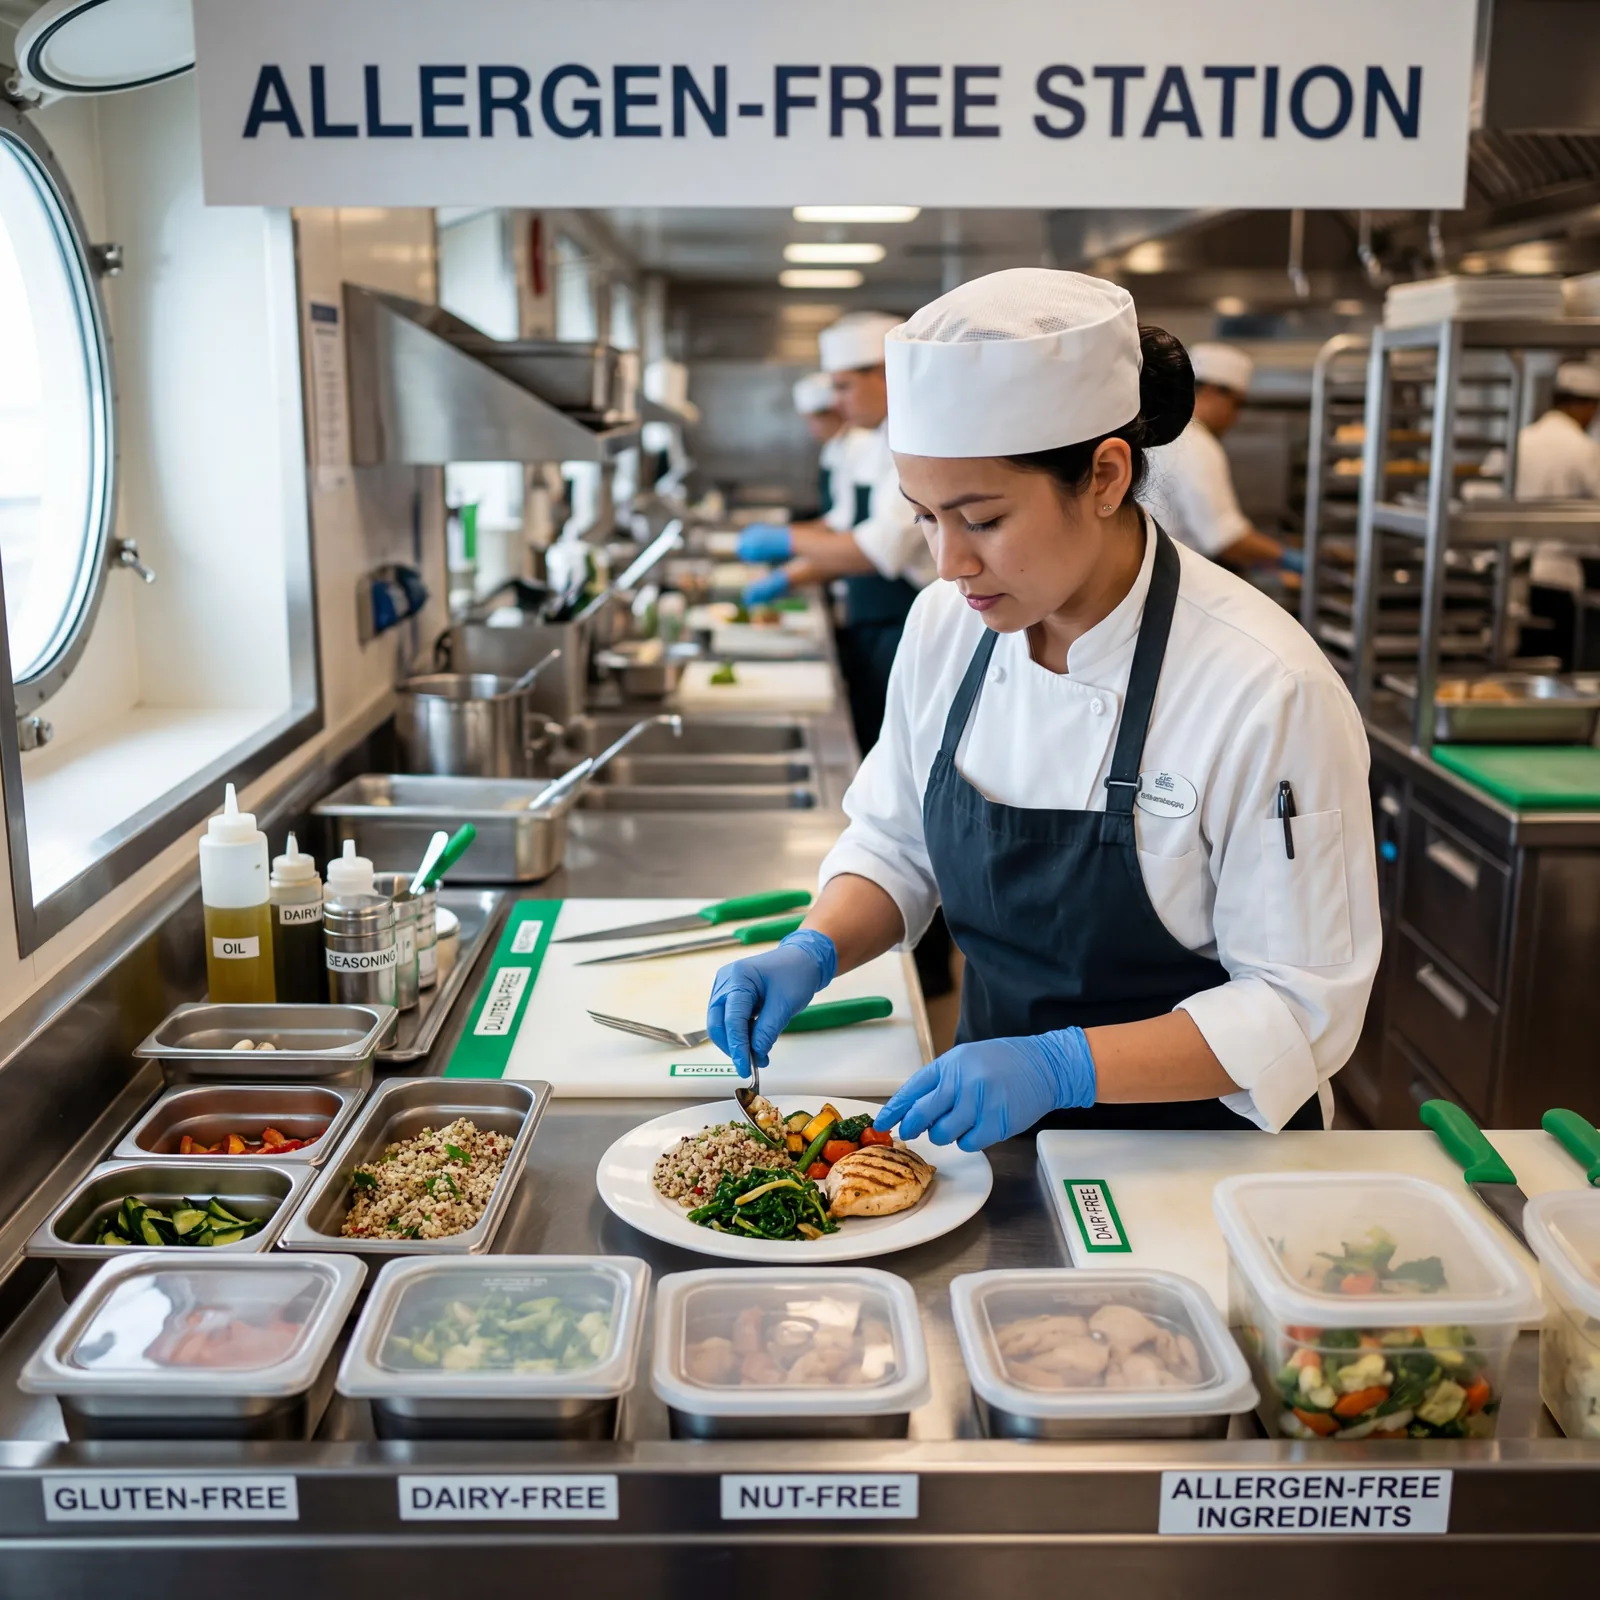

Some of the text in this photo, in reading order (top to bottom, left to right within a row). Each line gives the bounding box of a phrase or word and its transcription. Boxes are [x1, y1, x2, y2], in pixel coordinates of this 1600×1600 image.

[242, 64, 1423, 140] ALLERGEN-FREE STATION
[223, 942, 246, 954] OIL
[329, 950, 396, 969] SEASONING
[54, 1486, 287, 1511] GLUTEN-FREE
[411, 1486, 606, 1510] DAIRY-FREE
[740, 1485, 901, 1509] NUT-FREE
[1171, 1476, 1441, 1500] ALLERGEN-FREE
[1197, 1505, 1412, 1528] INGREDIENTS
